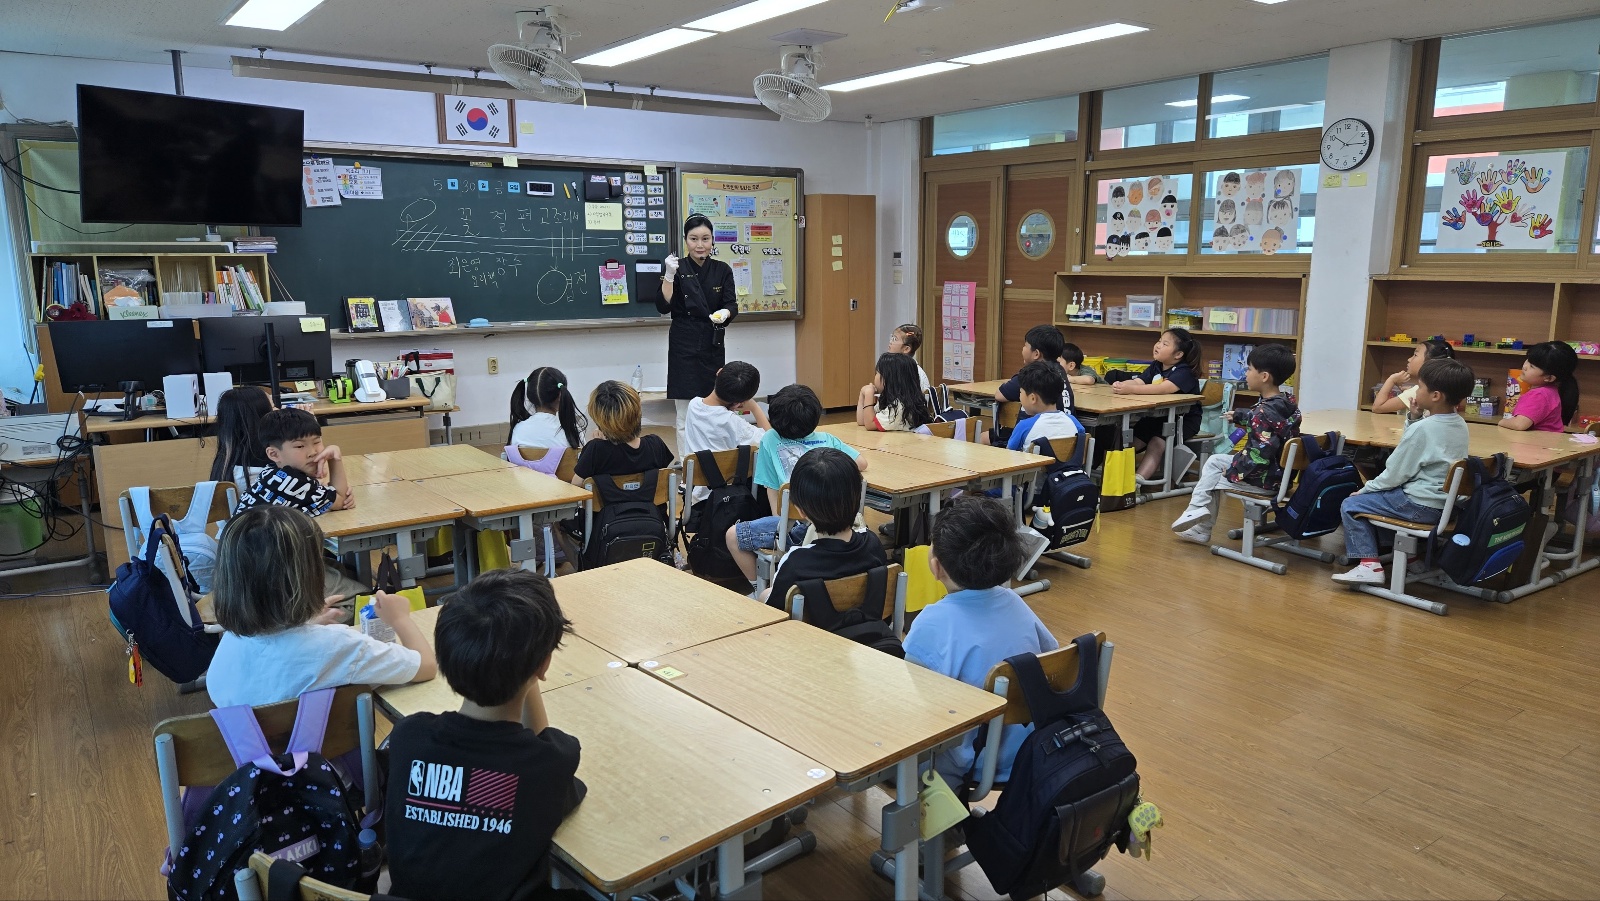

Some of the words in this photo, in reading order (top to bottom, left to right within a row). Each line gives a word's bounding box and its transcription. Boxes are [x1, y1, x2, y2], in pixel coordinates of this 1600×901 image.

[433, 178, 443, 191] 5
[461, 179, 476, 193] 30
[494, 180, 504, 195] 금
[119, 309, 149, 319] Kleenex
[268, 475, 311, 500] FILA
[424, 763, 464, 802] NBA
[405, 804, 481, 831] ESTABLISHED
[481, 816, 513, 835] 1946
